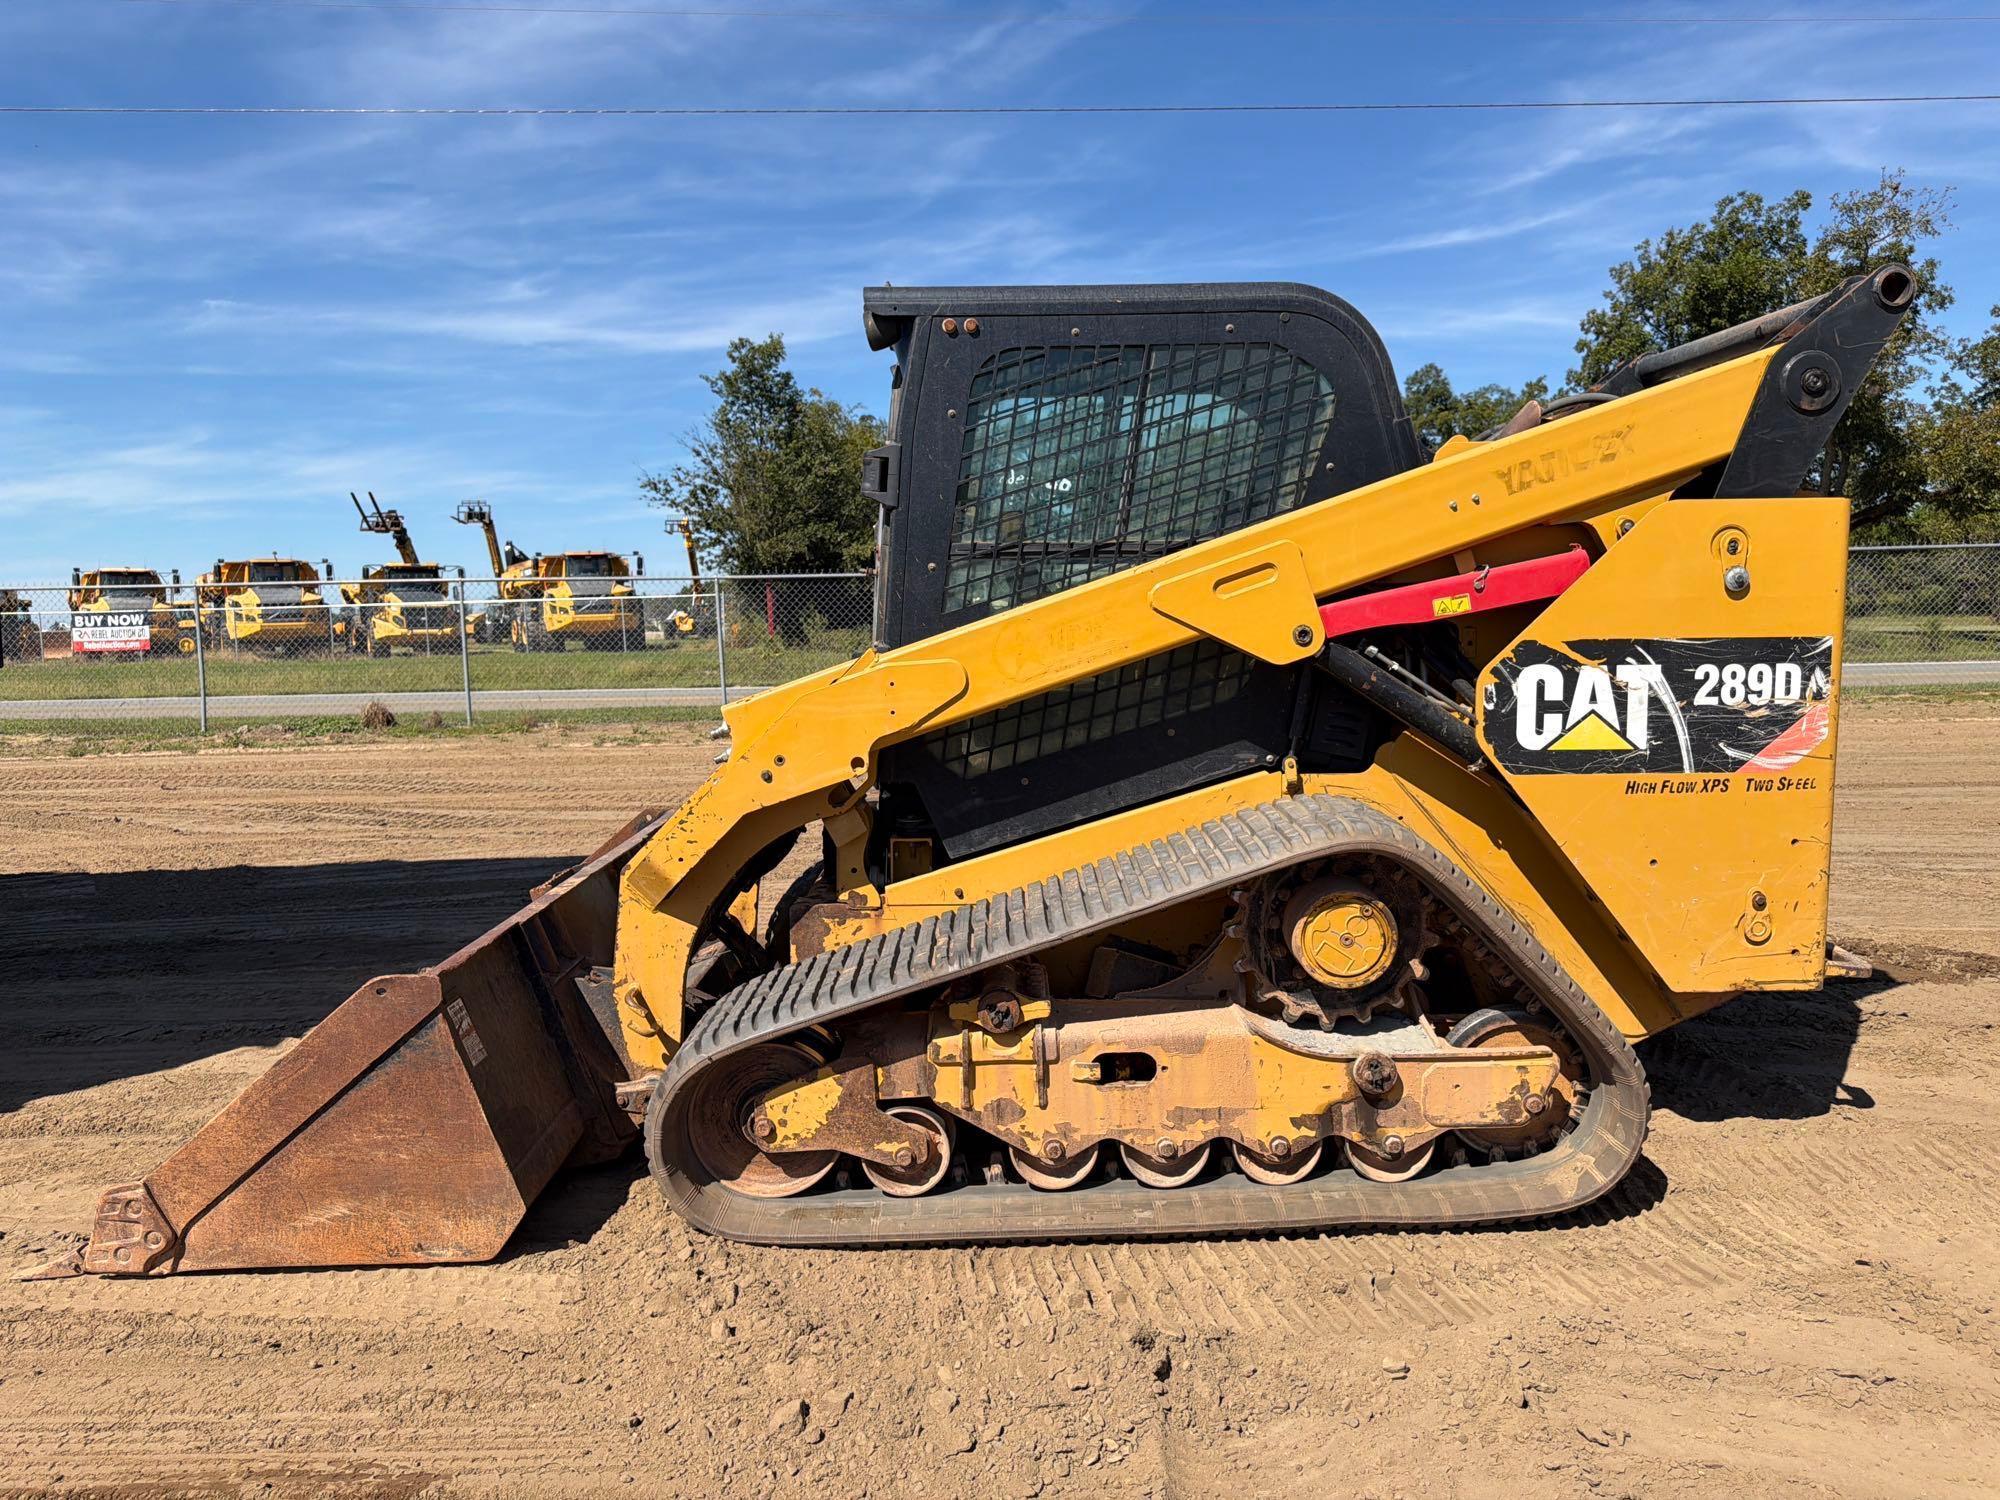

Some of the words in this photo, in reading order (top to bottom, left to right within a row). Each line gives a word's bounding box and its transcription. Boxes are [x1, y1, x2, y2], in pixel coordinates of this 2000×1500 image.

[74, 615, 104, 627] BUY
[107, 613, 144, 626] NOW
[91, 629, 108, 639] REBEL
[110, 629, 136, 639] AUCTION
[1516, 663, 1662, 751] CAT
[1693, 662, 1802, 707] 289D
[1625, 780, 1658, 795] HIGH
[1700, 778, 1730, 793] XPS
[1746, 777, 1774, 792] TWO
